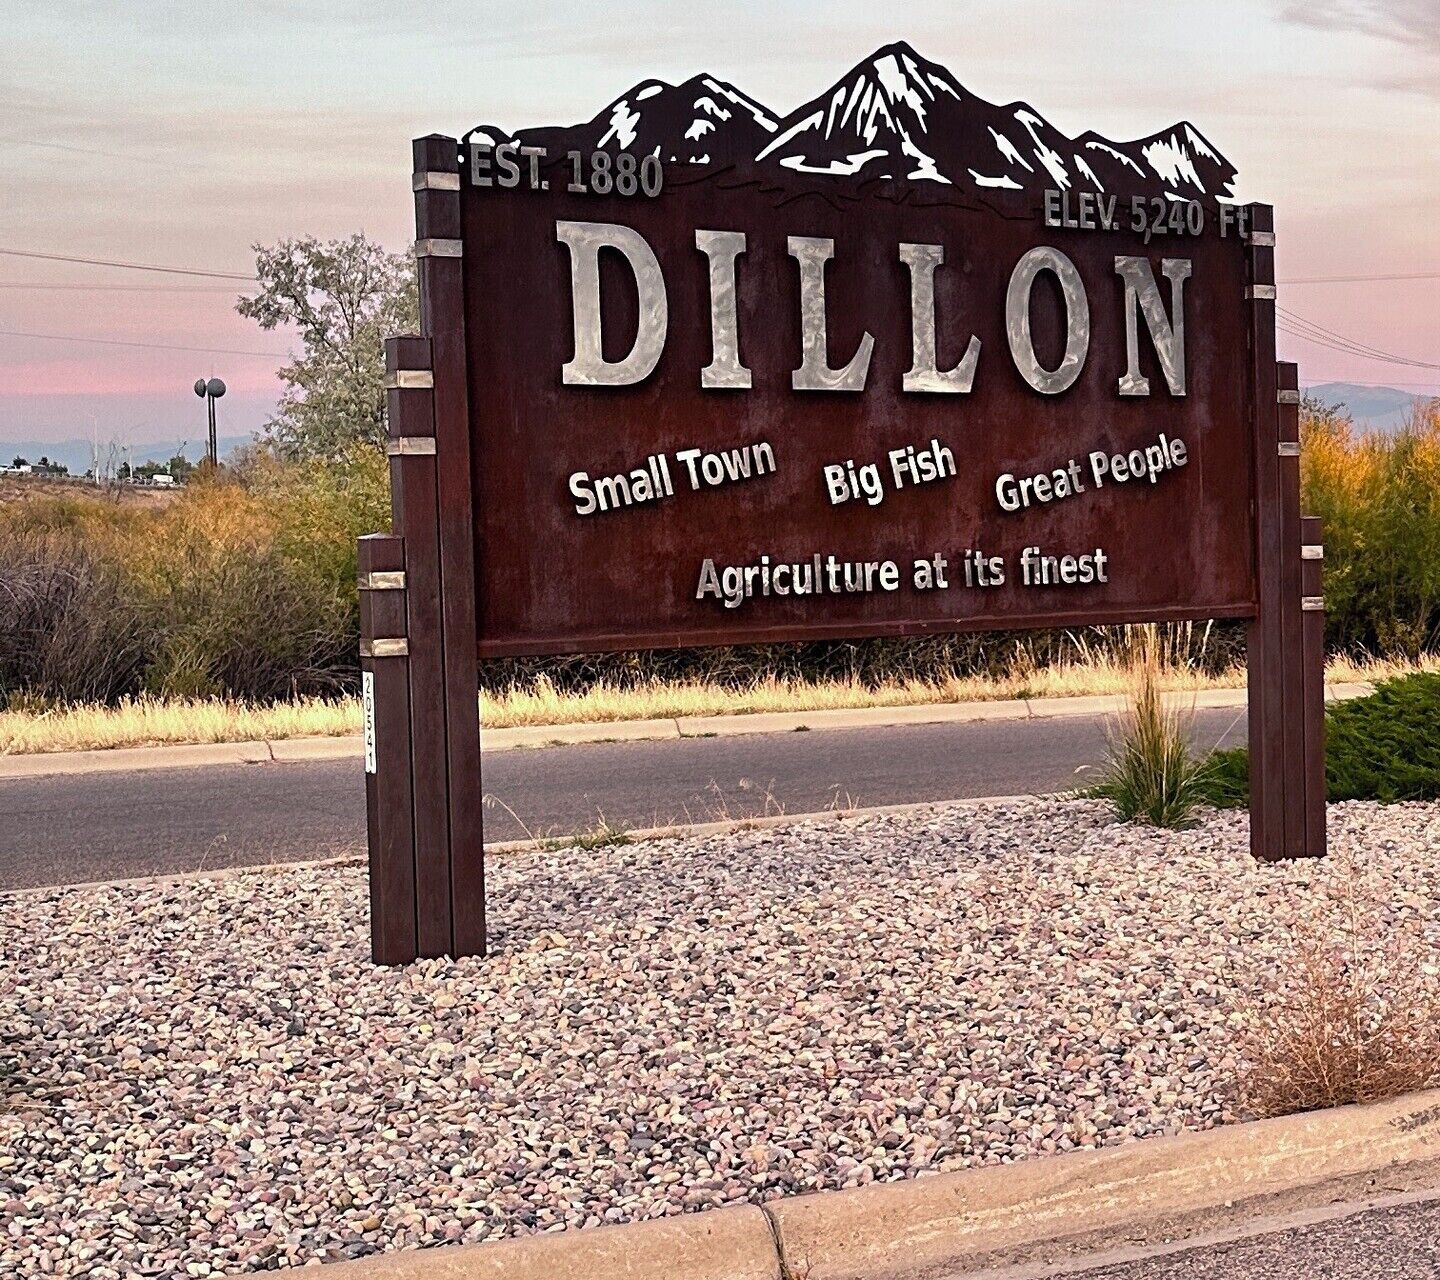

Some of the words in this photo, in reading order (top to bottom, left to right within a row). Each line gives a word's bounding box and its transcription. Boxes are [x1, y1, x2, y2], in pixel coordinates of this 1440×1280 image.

[470, 142, 550, 191] EST.
[566, 150, 664, 198] 1880
[1044, 189, 1120, 231] ELEV.
[1131, 196, 1204, 245] 5,240
[1219, 202, 1250, 239] Ft
[555, 220, 1193, 396] DILLON
[568, 453, 674, 515] Small
[676, 441, 776, 490] Town
[824, 460, 884, 506] Big
[888, 439, 957, 489] Fish
[995, 459, 1085, 511] Great
[1088, 433, 1188, 483] People
[695, 553, 900, 608] Agriculture
[913, 552, 949, 589] at
[964, 548, 1006, 587] its
[1020, 546, 1108, 585] finest
